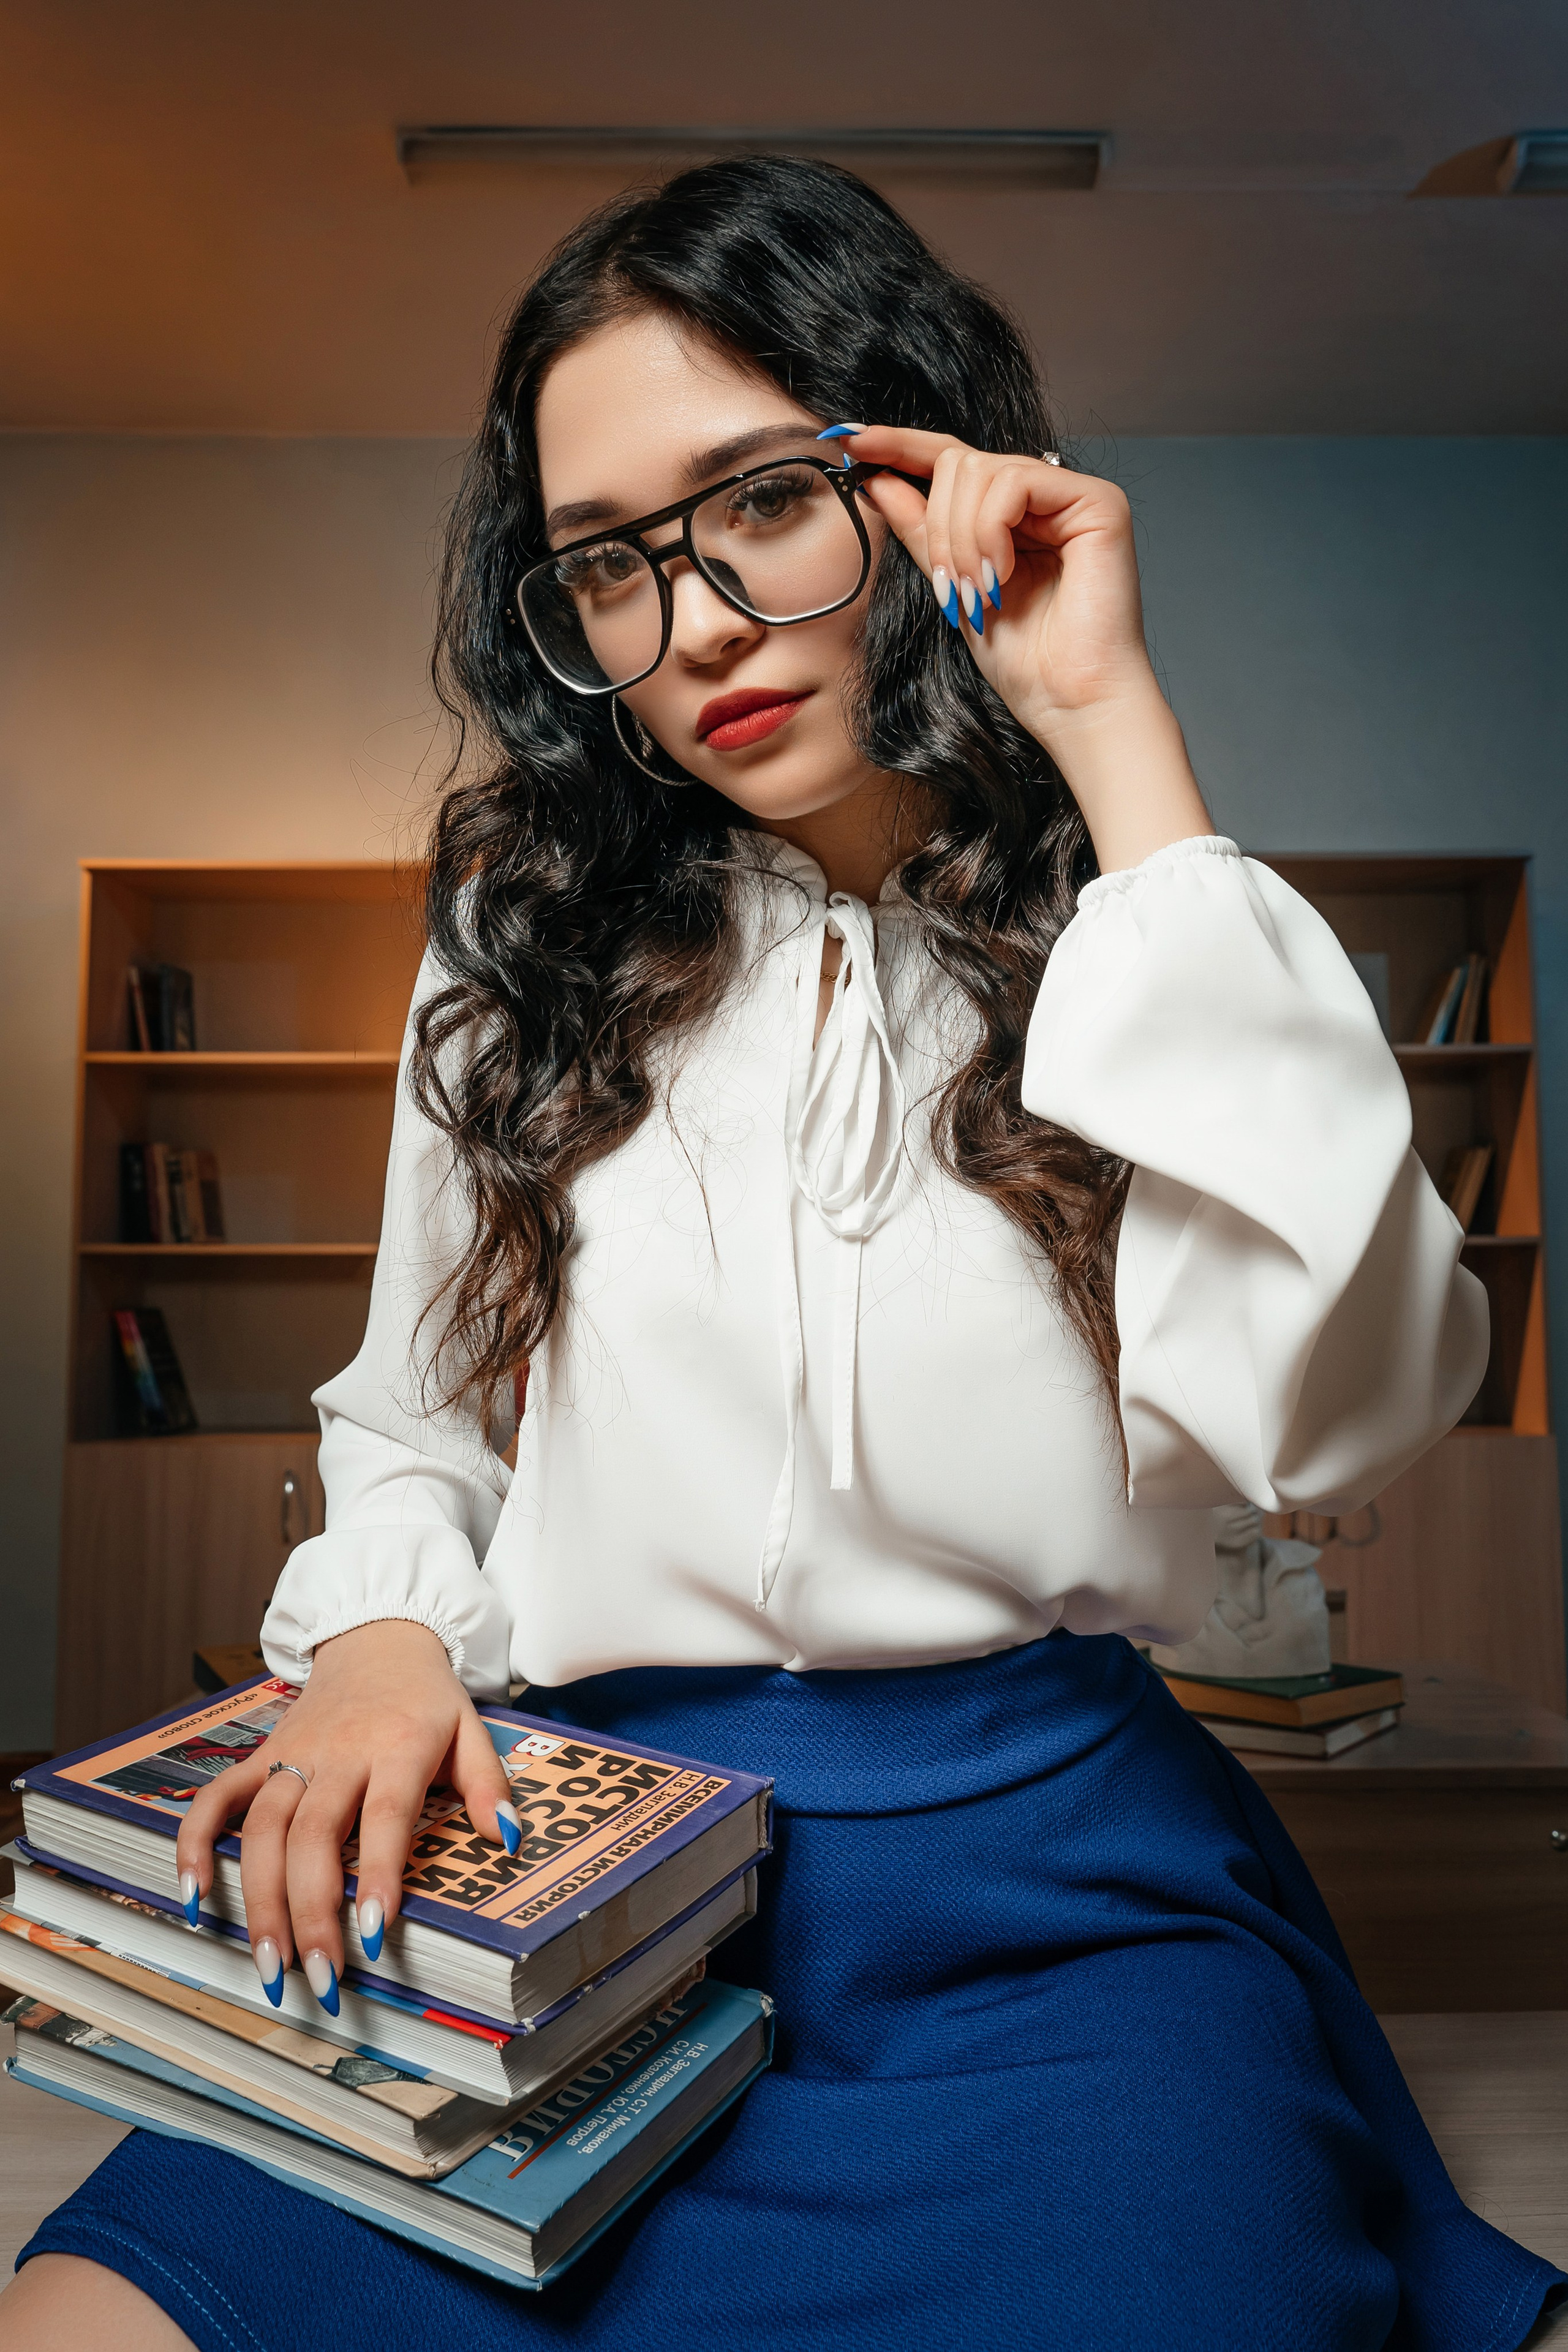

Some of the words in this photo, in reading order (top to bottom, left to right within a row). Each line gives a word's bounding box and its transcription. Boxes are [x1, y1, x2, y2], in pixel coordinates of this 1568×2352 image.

[157, 1717, 202, 1739] слово»
[512, 1733, 566, 1757] В
[545, 1744, 601, 1771] И
[673, 1773, 700, 1790] Н.В.
[610, 1789, 677, 1831] Загладин
[610, 1779, 724, 1858] ВСЕМИРНАЯ
[437, 1763, 674, 1906] ИСТОРИЯ
[514, 1856, 617, 1921] ИСТОРИЯ
[684, 2042, 709, 2059] Н.В.
[565, 2114, 605, 2147] Петров
[577, 2113, 631, 2155] Минаков,
